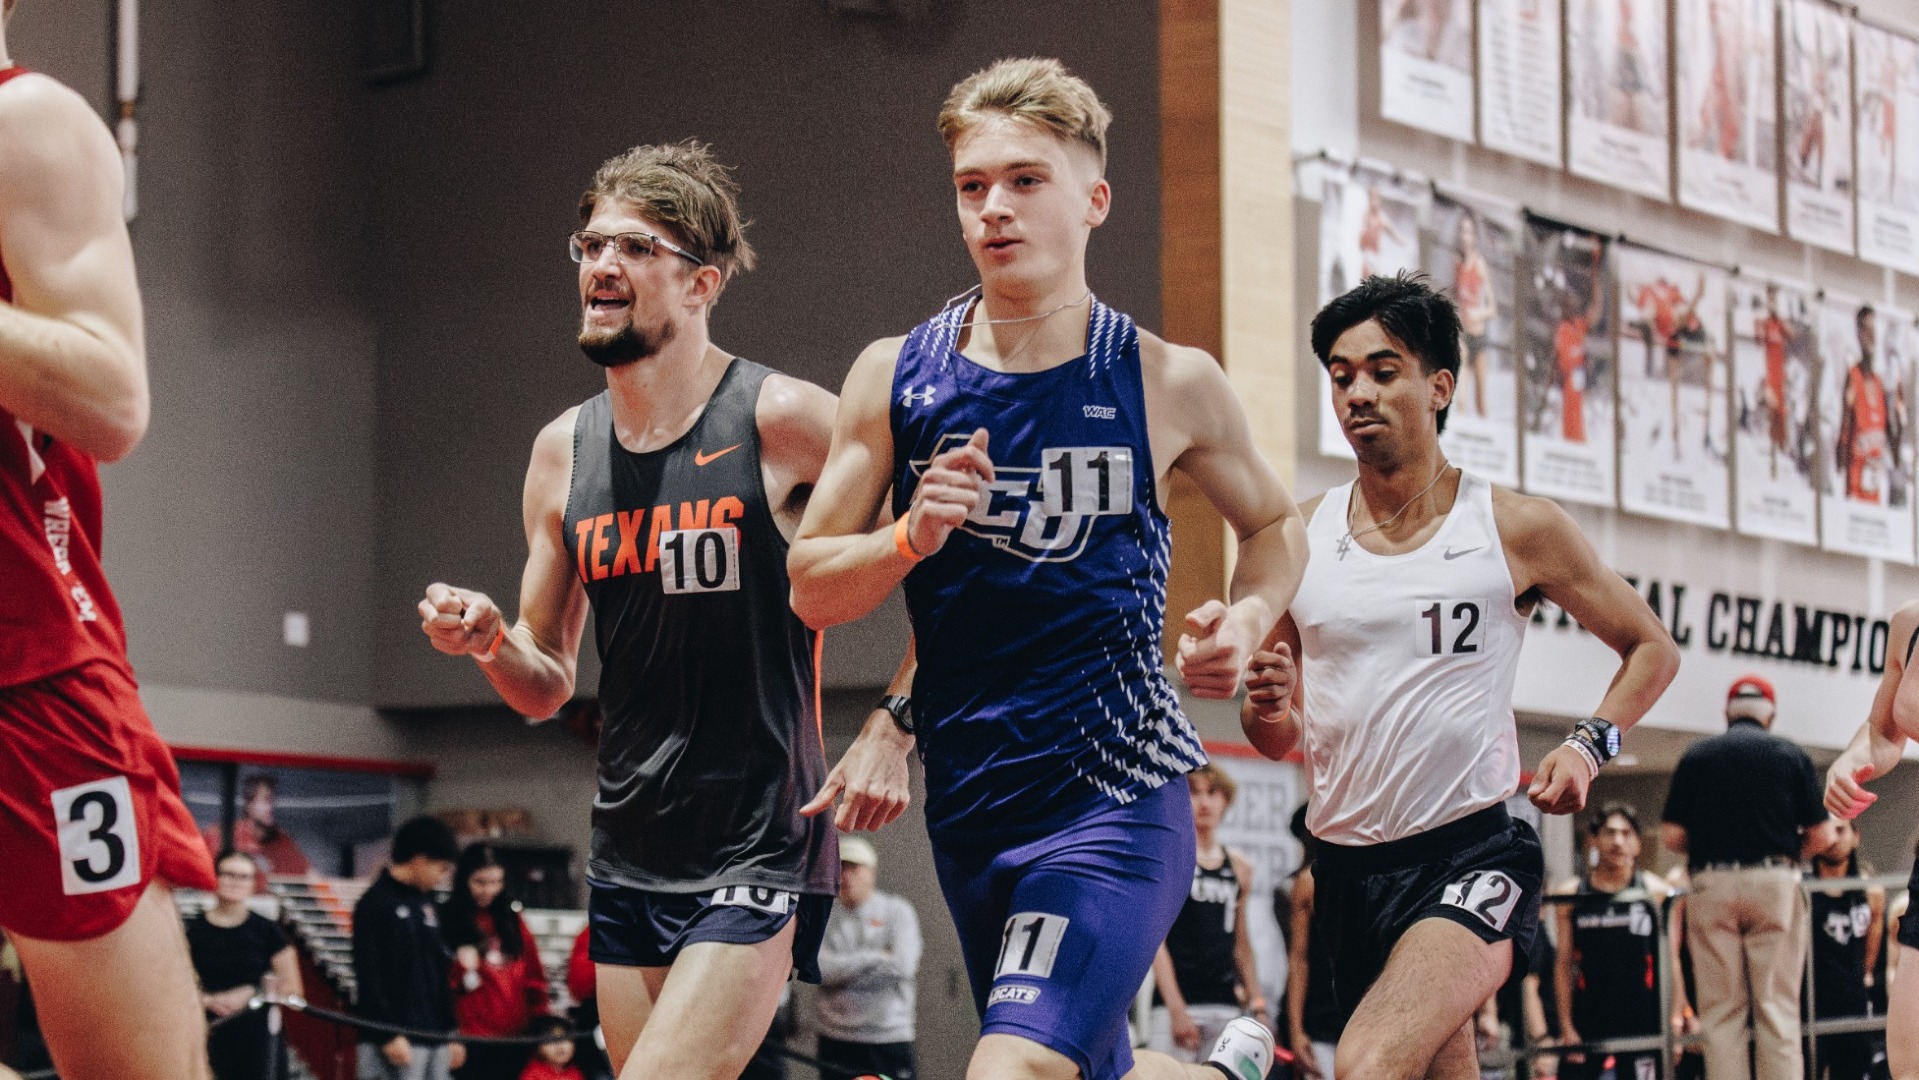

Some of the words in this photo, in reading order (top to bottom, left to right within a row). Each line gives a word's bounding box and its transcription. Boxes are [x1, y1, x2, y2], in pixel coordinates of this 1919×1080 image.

[1083, 405, 1116, 419] WAC
[1049, 450, 1110, 512] 11
[664, 531, 727, 590] 10
[1422, 602, 1480, 655] 12
[69, 790, 126, 883] 3
[1455, 872, 1512, 927] 12
[997, 917, 1046, 975] 11
